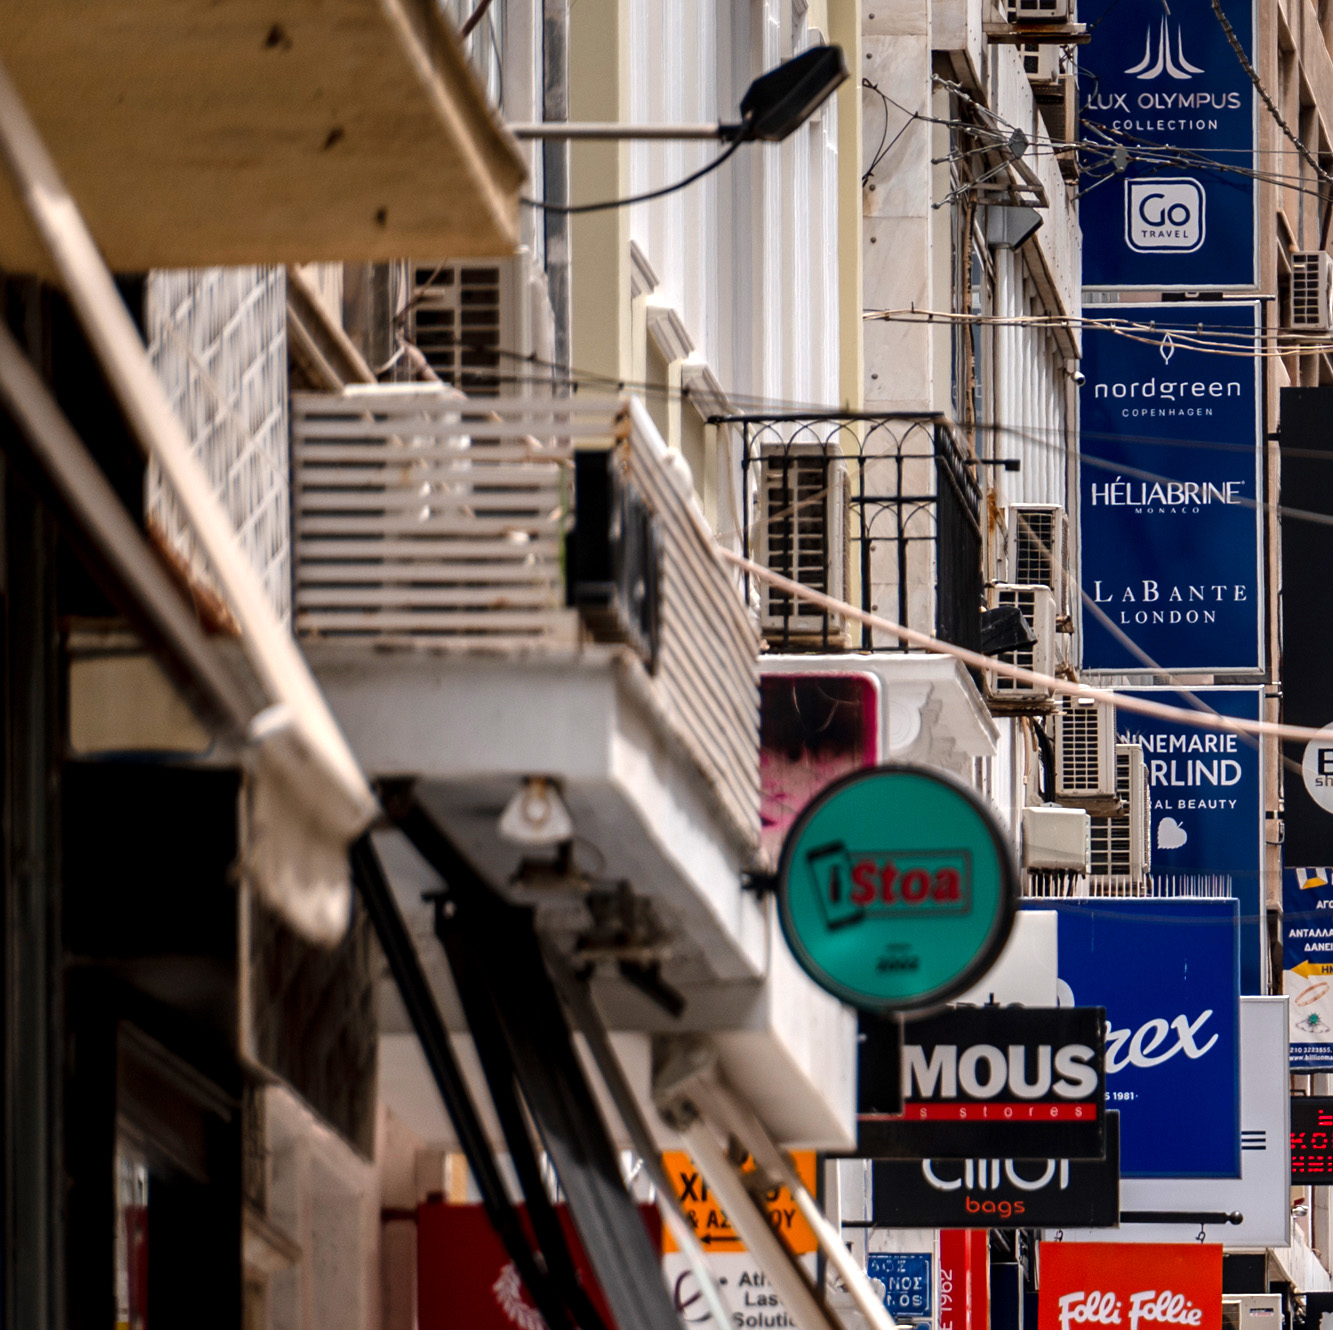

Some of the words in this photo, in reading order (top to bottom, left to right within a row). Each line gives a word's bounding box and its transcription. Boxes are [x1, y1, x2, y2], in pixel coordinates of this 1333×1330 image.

[1086, 92, 1130, 111] LUX
[1137, 91, 1242, 110] OLYMPUS
[1112, 119, 1219, 131] COLLECTION
[1138, 192, 1191, 229] Go
[1141, 229, 1190, 240] TRAVEL
[1094, 377, 1242, 402] nordgreen
[1121, 407, 1213, 418] COPENHAGEN
[1134, 506, 1202, 515] MONACO
[1120, 610, 1217, 624] LONDON
[1177, 799, 1238, 810] BEAUTY
[902, 1043, 1099, 1099] MOUS
[959, 1104, 1083, 1118] stores
[965, 1196, 1026, 1218] bags
[940, 1269, 953, 1311] 1962
